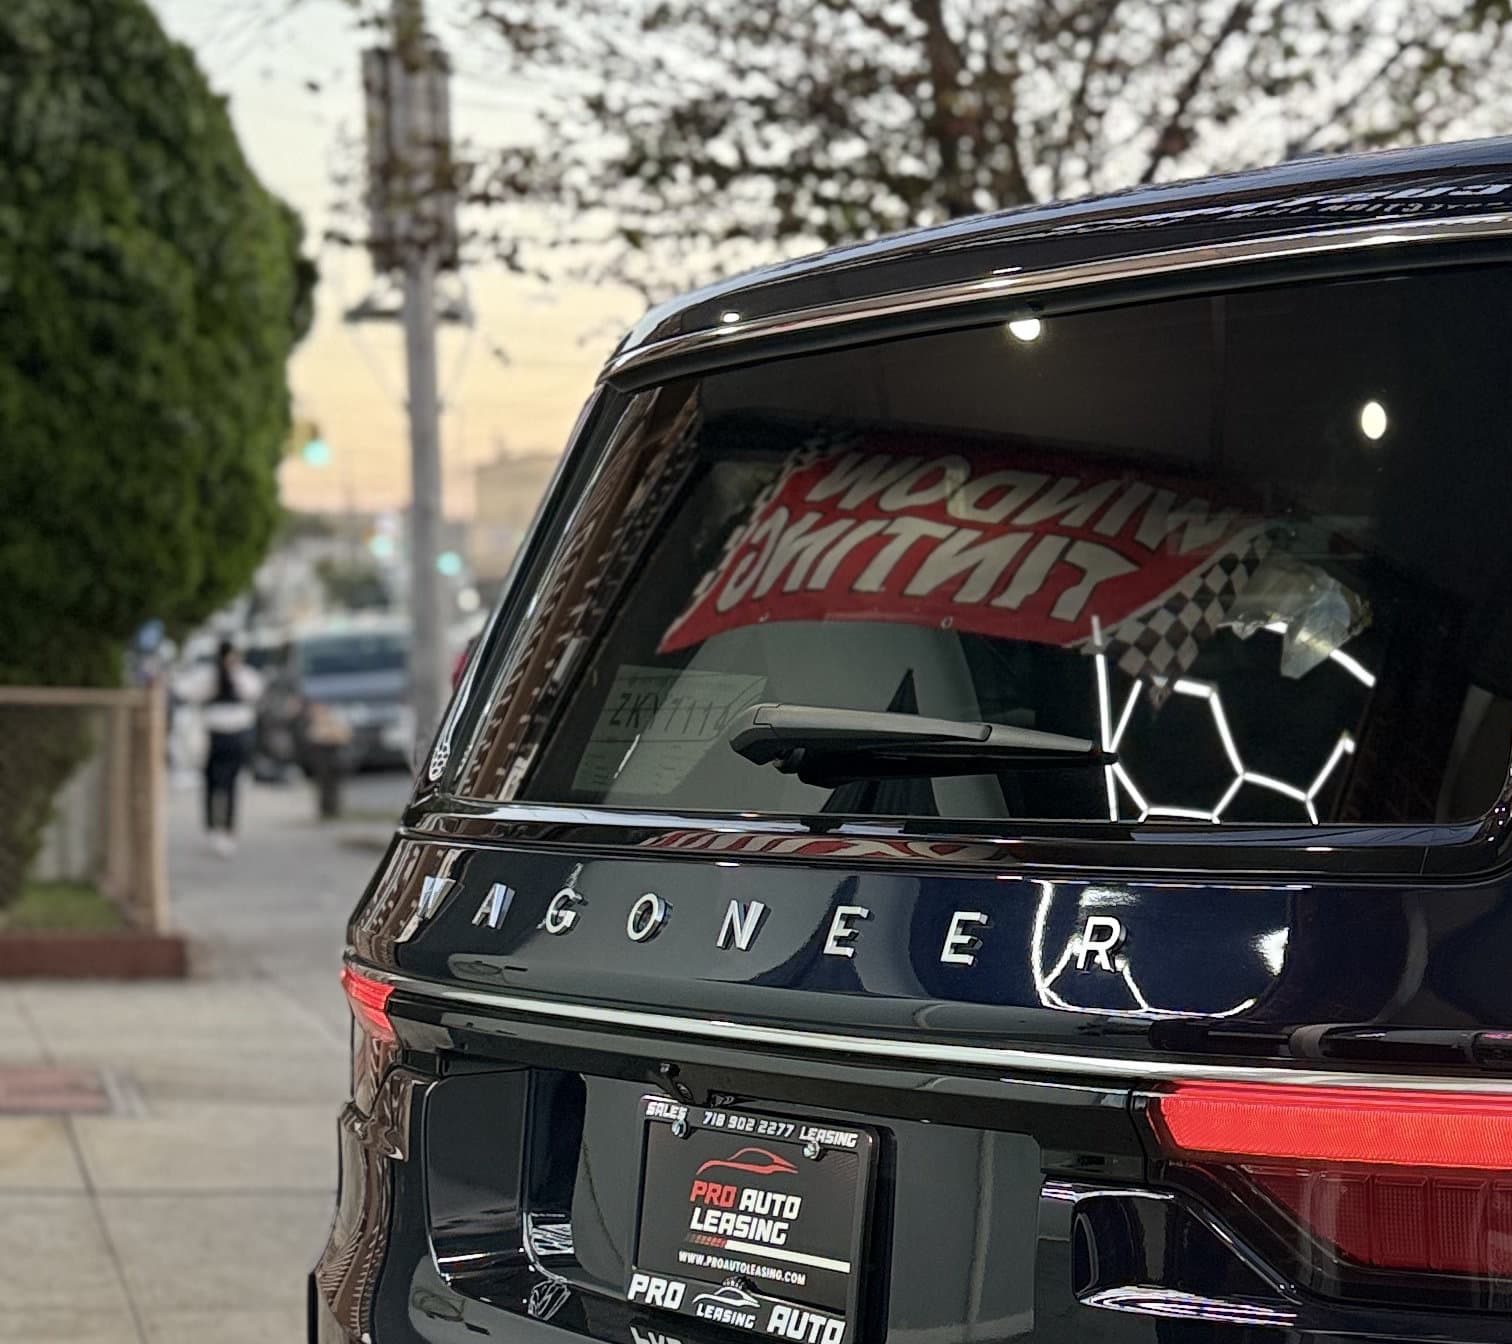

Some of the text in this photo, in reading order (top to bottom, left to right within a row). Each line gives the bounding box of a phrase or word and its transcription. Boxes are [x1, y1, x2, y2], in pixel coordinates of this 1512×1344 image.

[416, 875, 1127, 971] WAGONEER
[646, 1102, 859, 1148] SALES 718 902 2277 LEASING
[689, 1180, 802, 1220] PRO AUTO
[689, 1207, 789, 1246] LEASING
[678, 1250, 806, 1286] WWW.PROAUTOLEASING.COM
[627, 1273, 686, 1310] PRO
[696, 1303, 756, 1329] LEASING
